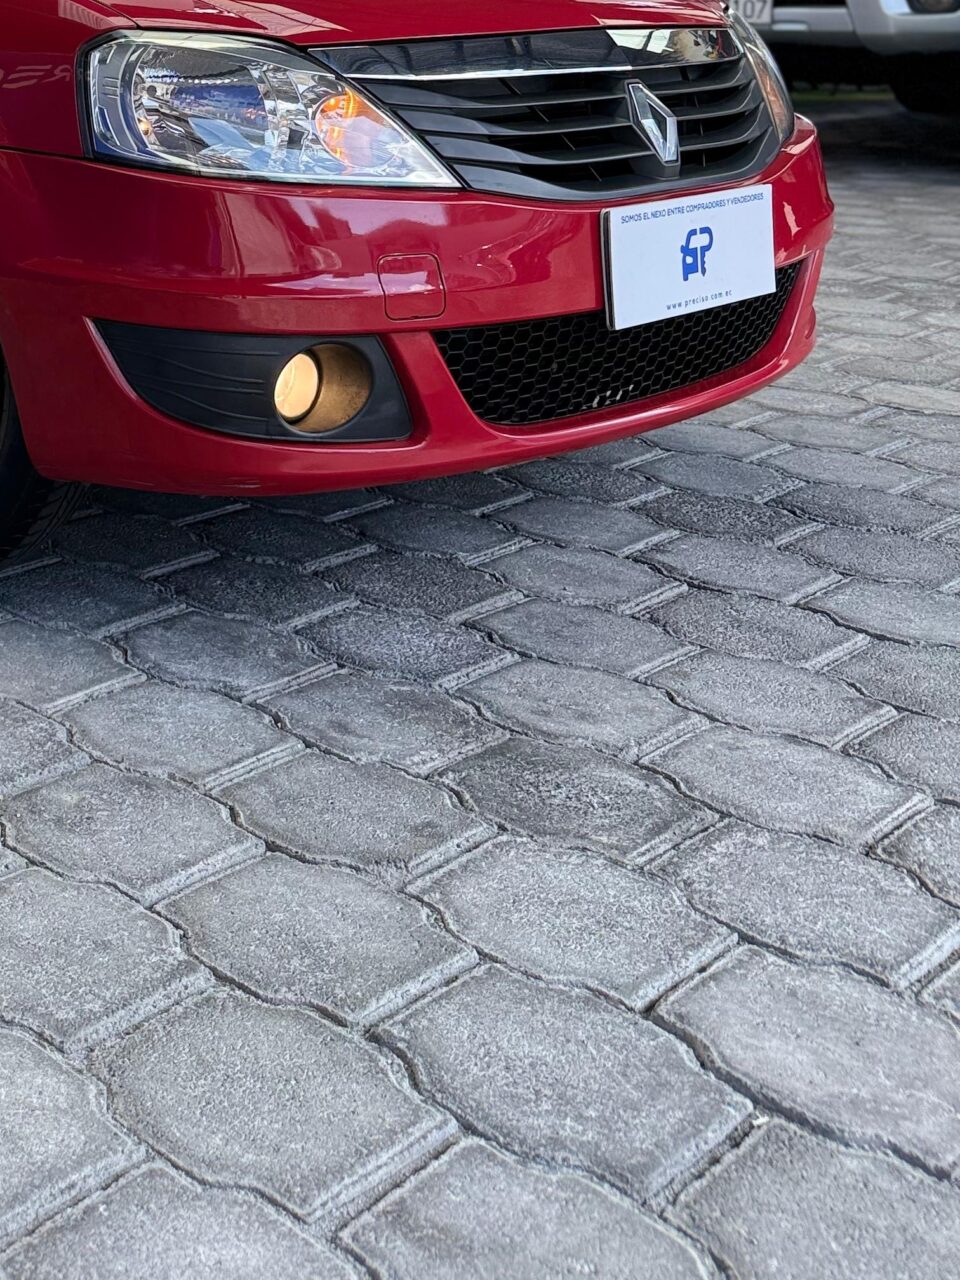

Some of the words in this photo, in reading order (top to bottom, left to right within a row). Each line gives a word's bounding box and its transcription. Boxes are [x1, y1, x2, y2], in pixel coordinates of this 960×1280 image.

[621, 212, 642, 224] SOMOS
[643, 211, 650, 221] EL
[651, 209, 667, 218] NEXO
[667, 205, 685, 216] ENTRE
[686, 199, 727, 213] COMPRADORES
[731, 192, 764, 206] VENDEDORES
[666, 290, 732, 310] wwwprecisocomec
